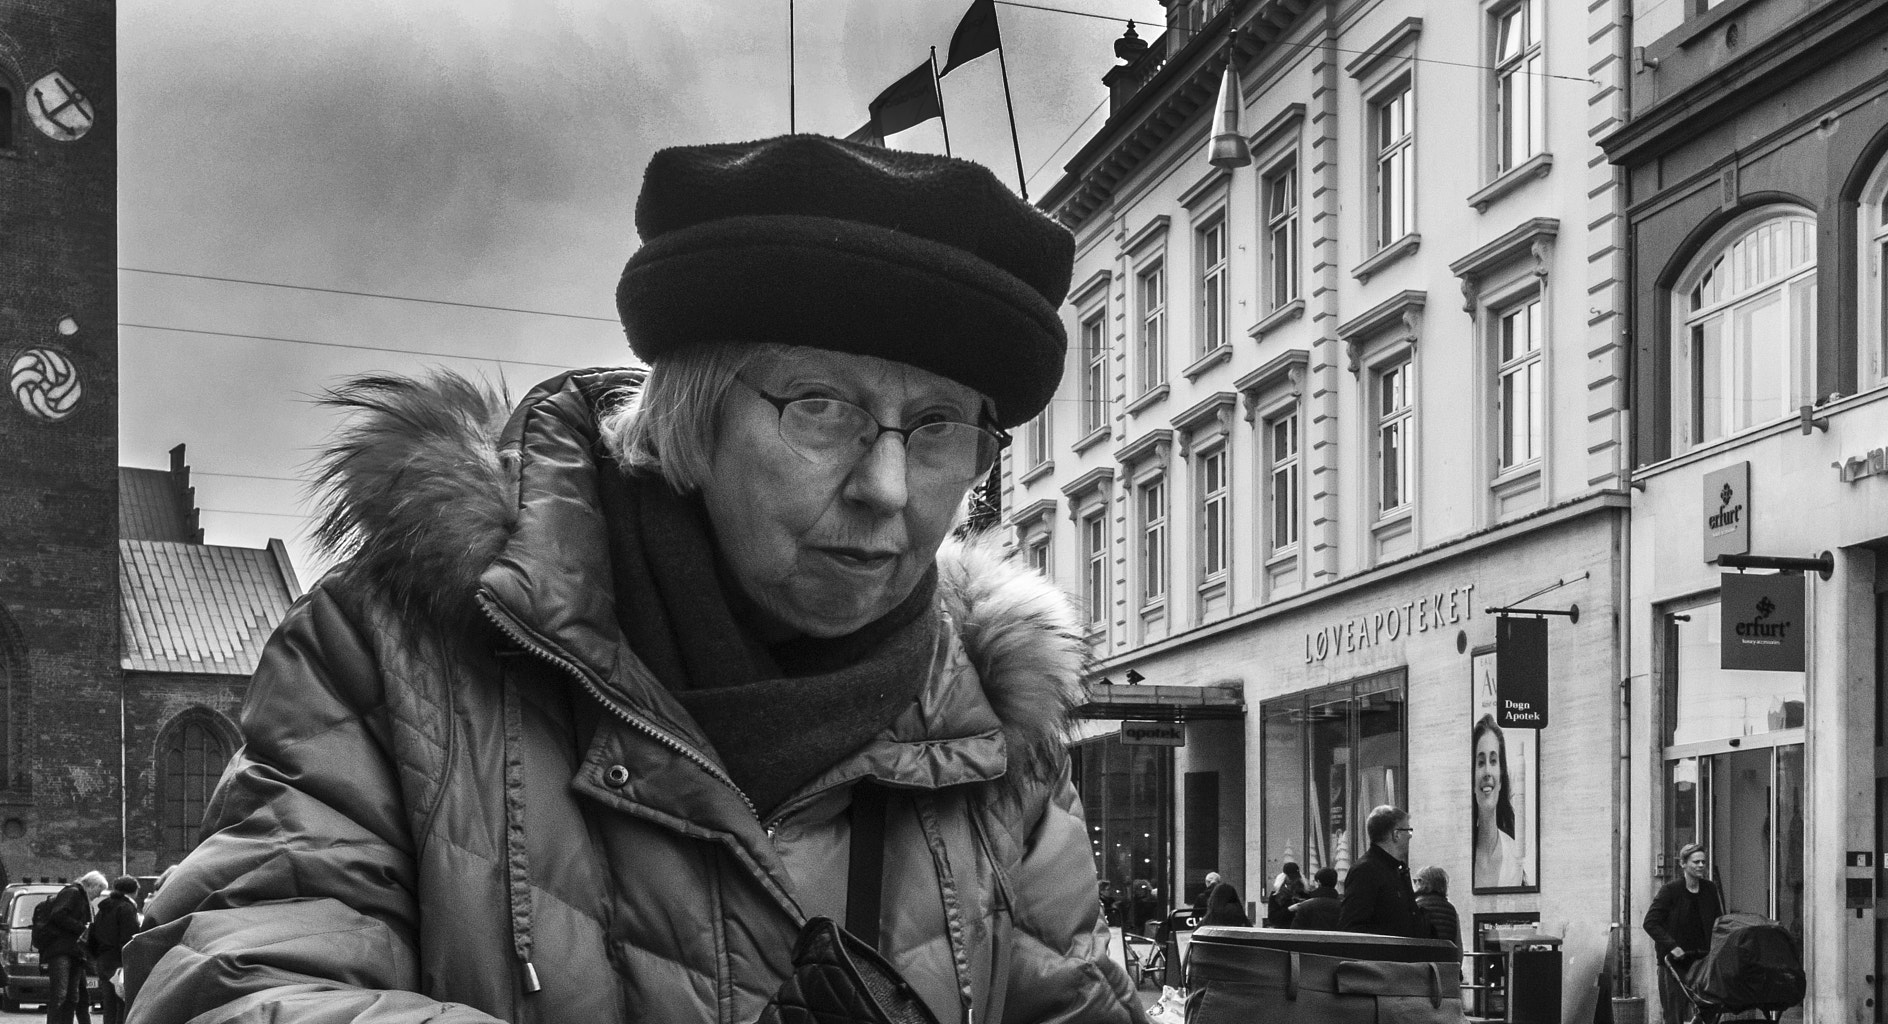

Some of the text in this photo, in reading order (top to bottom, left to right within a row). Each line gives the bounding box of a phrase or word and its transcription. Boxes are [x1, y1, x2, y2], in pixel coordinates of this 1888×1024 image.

[1709, 504, 1741, 529] erfurt
[1305, 584, 1474, 664] LØVEAPOTEKET
[1735, 616, 1787, 637] erfurt
[1505, 711, 1540, 722] Apotek
[1126, 727, 1181, 741] apotek
